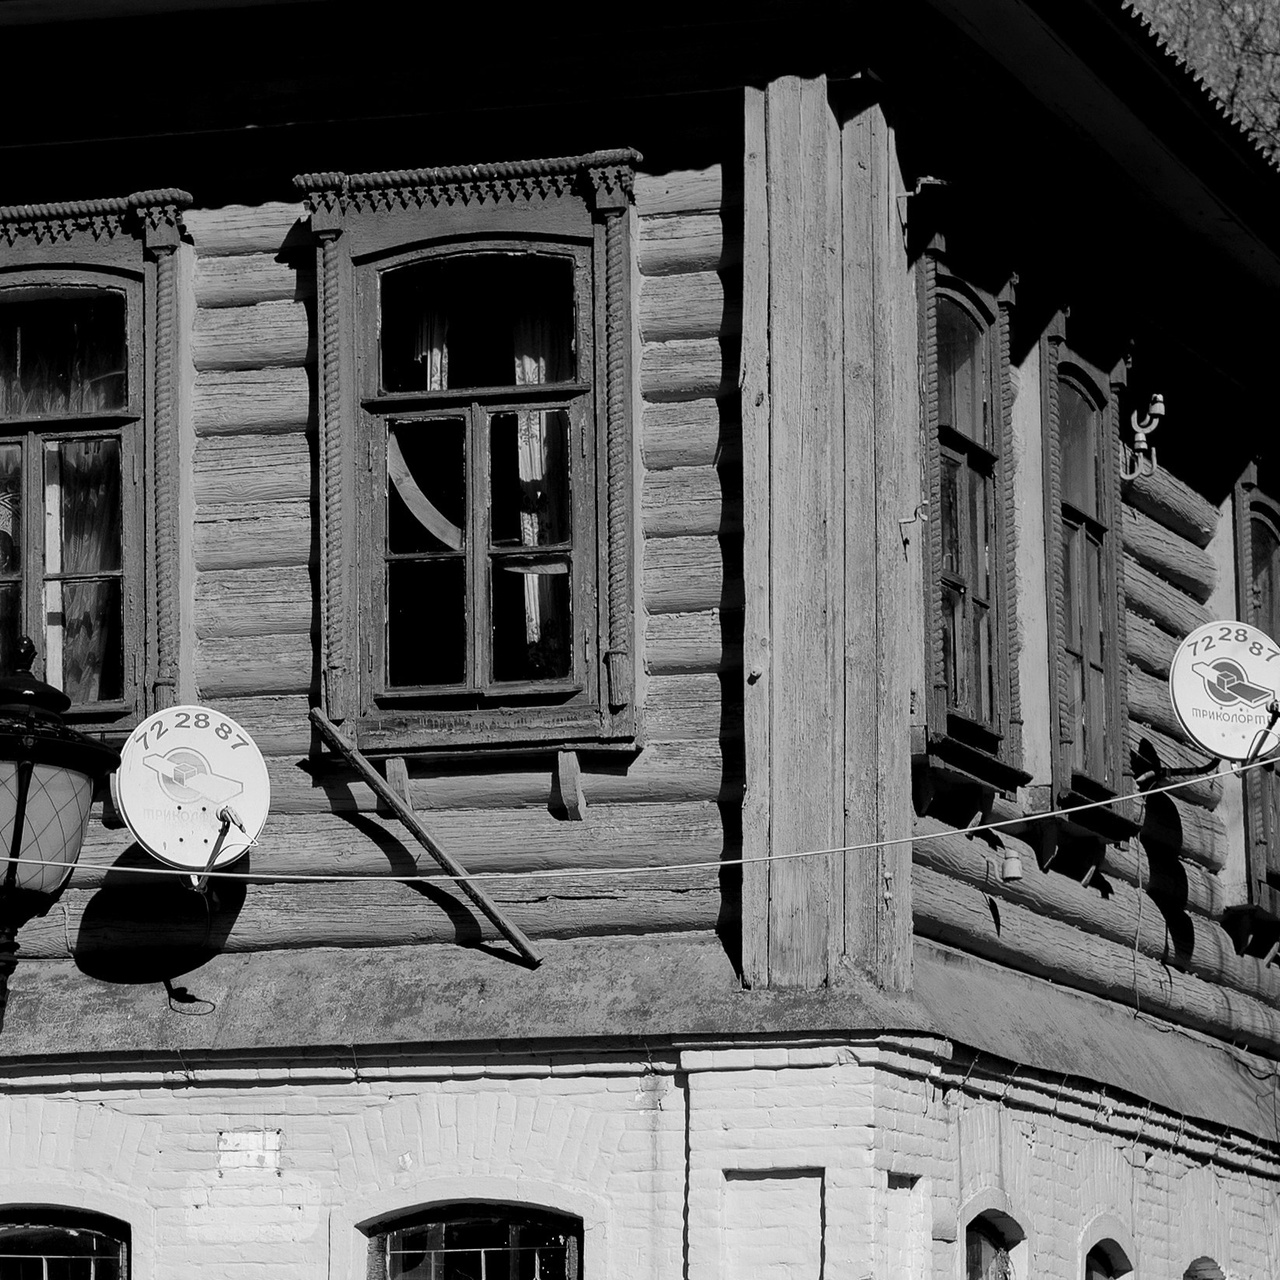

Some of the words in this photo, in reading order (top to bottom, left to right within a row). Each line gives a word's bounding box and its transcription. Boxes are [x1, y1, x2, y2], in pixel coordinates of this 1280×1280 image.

[1187, 635, 1216, 656] 72
[1218, 627, 1248, 642] 28
[1249, 641, 1280, 662] 87
[135, 720, 168, 750] 72
[174, 712, 210, 729] 28
[214, 722, 250, 750] 87
